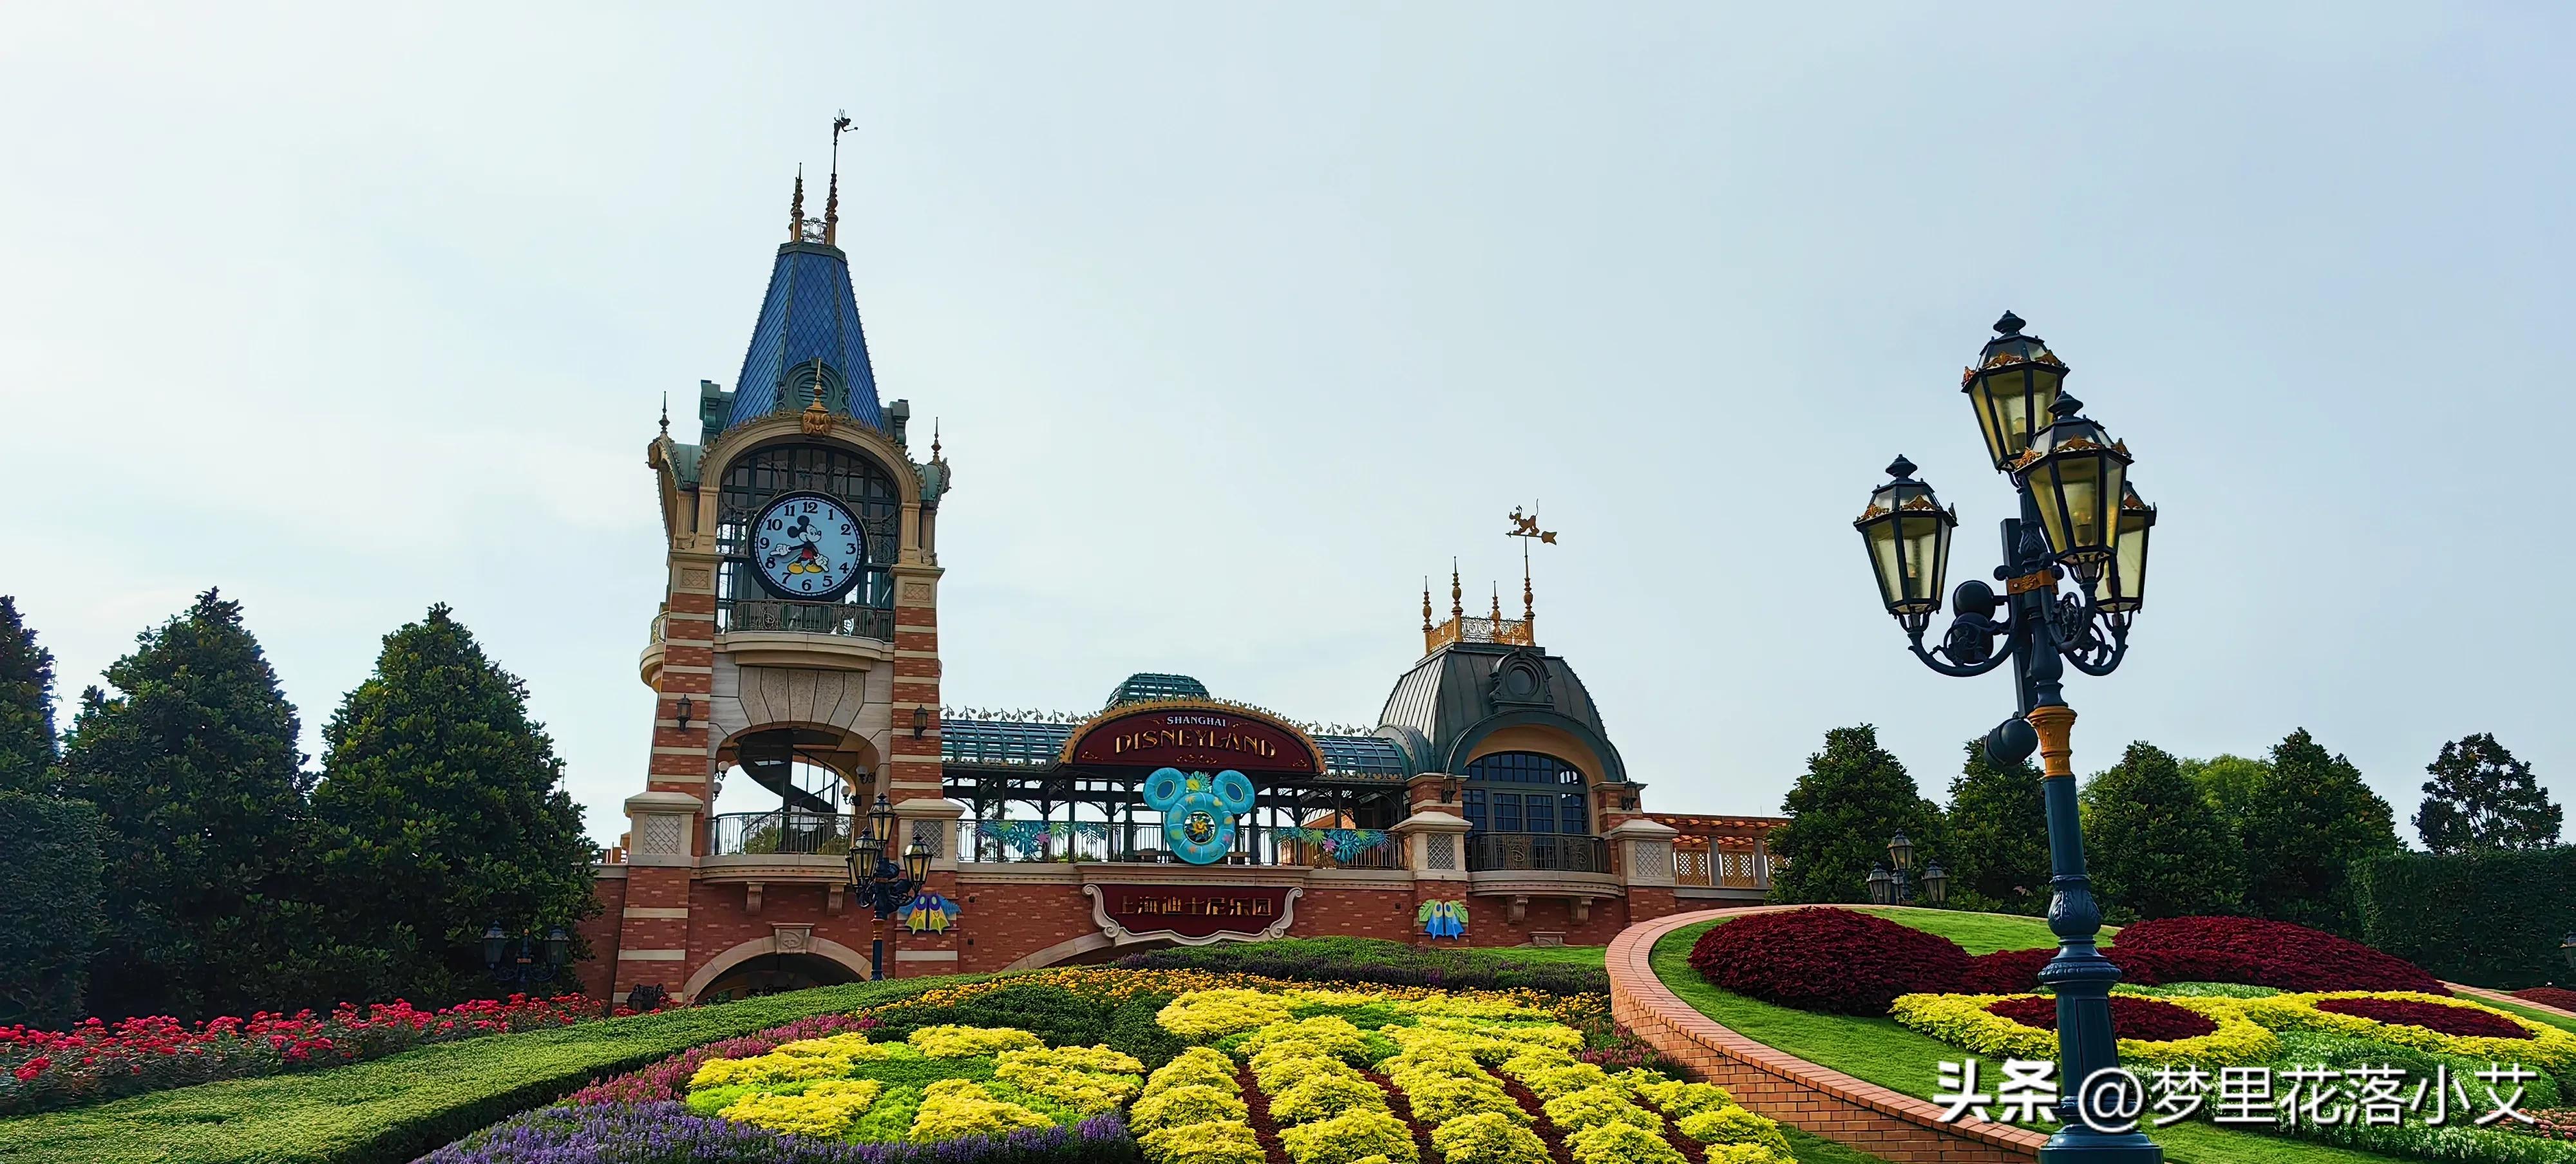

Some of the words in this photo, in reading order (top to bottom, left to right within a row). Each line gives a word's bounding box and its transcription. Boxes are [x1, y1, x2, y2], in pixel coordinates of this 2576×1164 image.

[784, 504, 795, 516] 11
[802, 502, 818, 514] 12
[828, 509, 833, 520] 1
[766, 519, 783, 531] 10
[840, 524, 851, 536] 2
[760, 538, 770, 549] 9
[846, 543, 857, 555] 3
[765, 557, 776, 569] 8
[839, 562, 849, 574] 4
[782, 572, 792, 585] 7
[822, 576, 833, 587] 5
[802, 579, 812, 591] 6
[1166, 716, 1226, 727] SHANGHAI
[1115, 729, 1276, 758] DISNEYLAND
[1115, 896, 1273, 915] 上海迪士尼乐园
